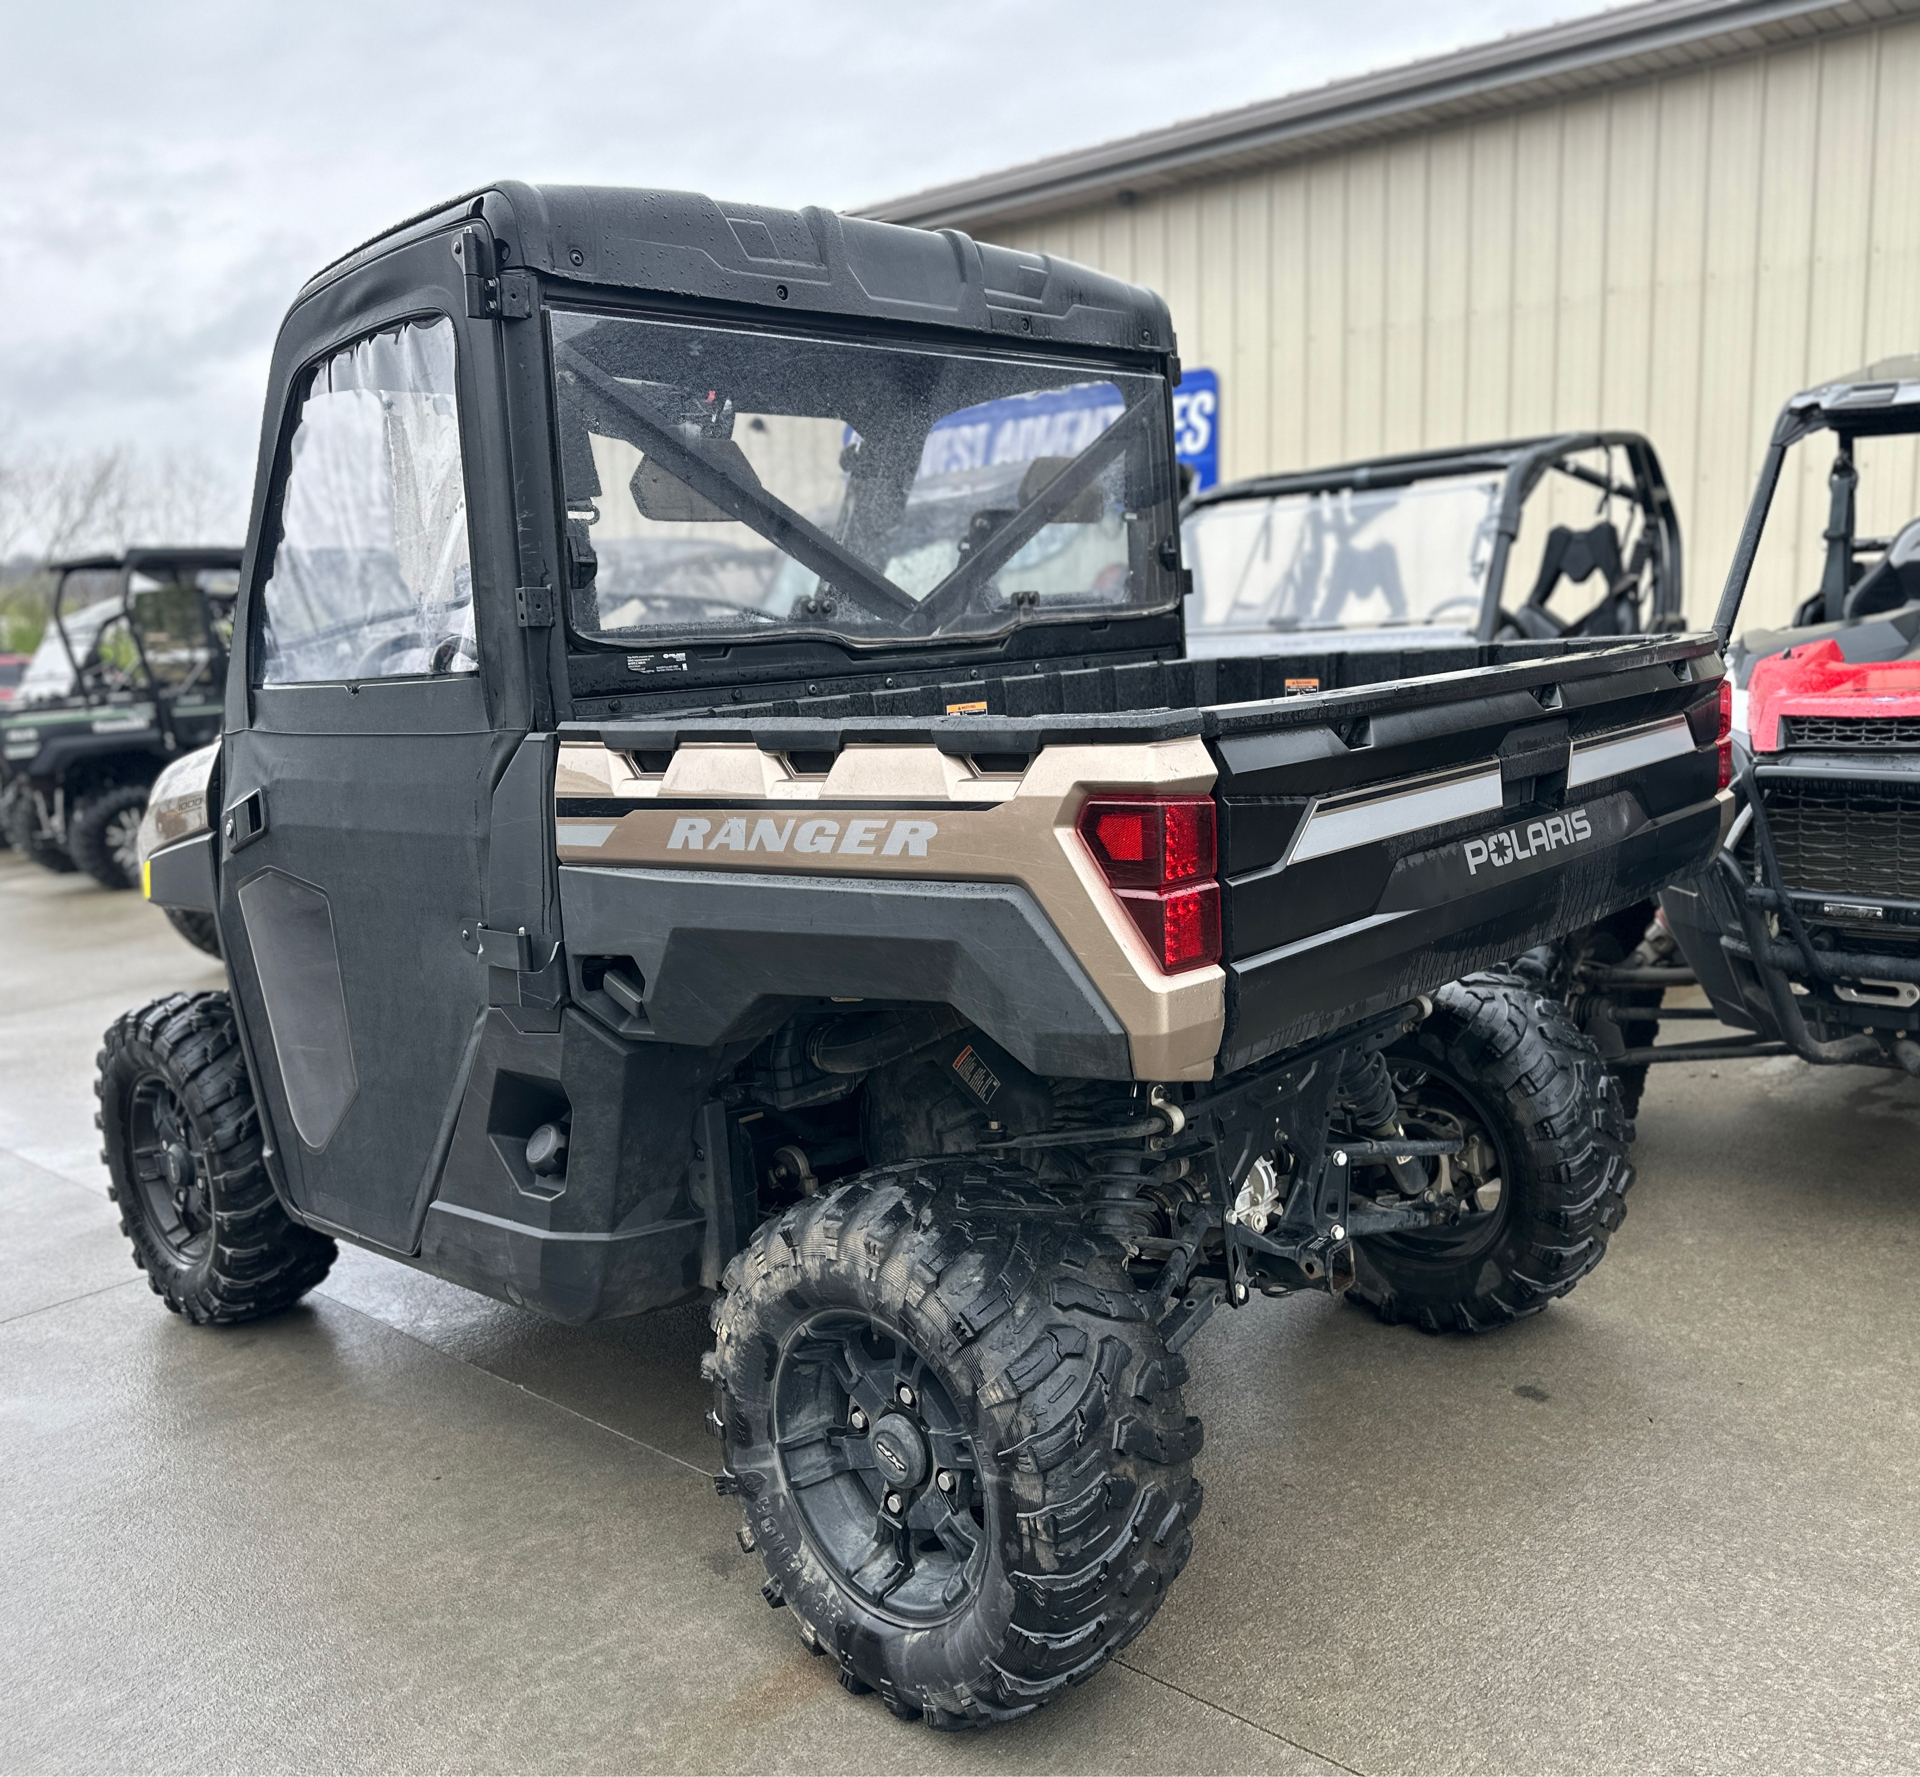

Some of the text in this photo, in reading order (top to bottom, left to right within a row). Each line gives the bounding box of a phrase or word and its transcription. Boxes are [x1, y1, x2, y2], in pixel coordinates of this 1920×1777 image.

[178, 797, 203, 812] 1000
[666, 817, 938, 857] RANGER
[1463, 808, 1592, 876] POLARIS
